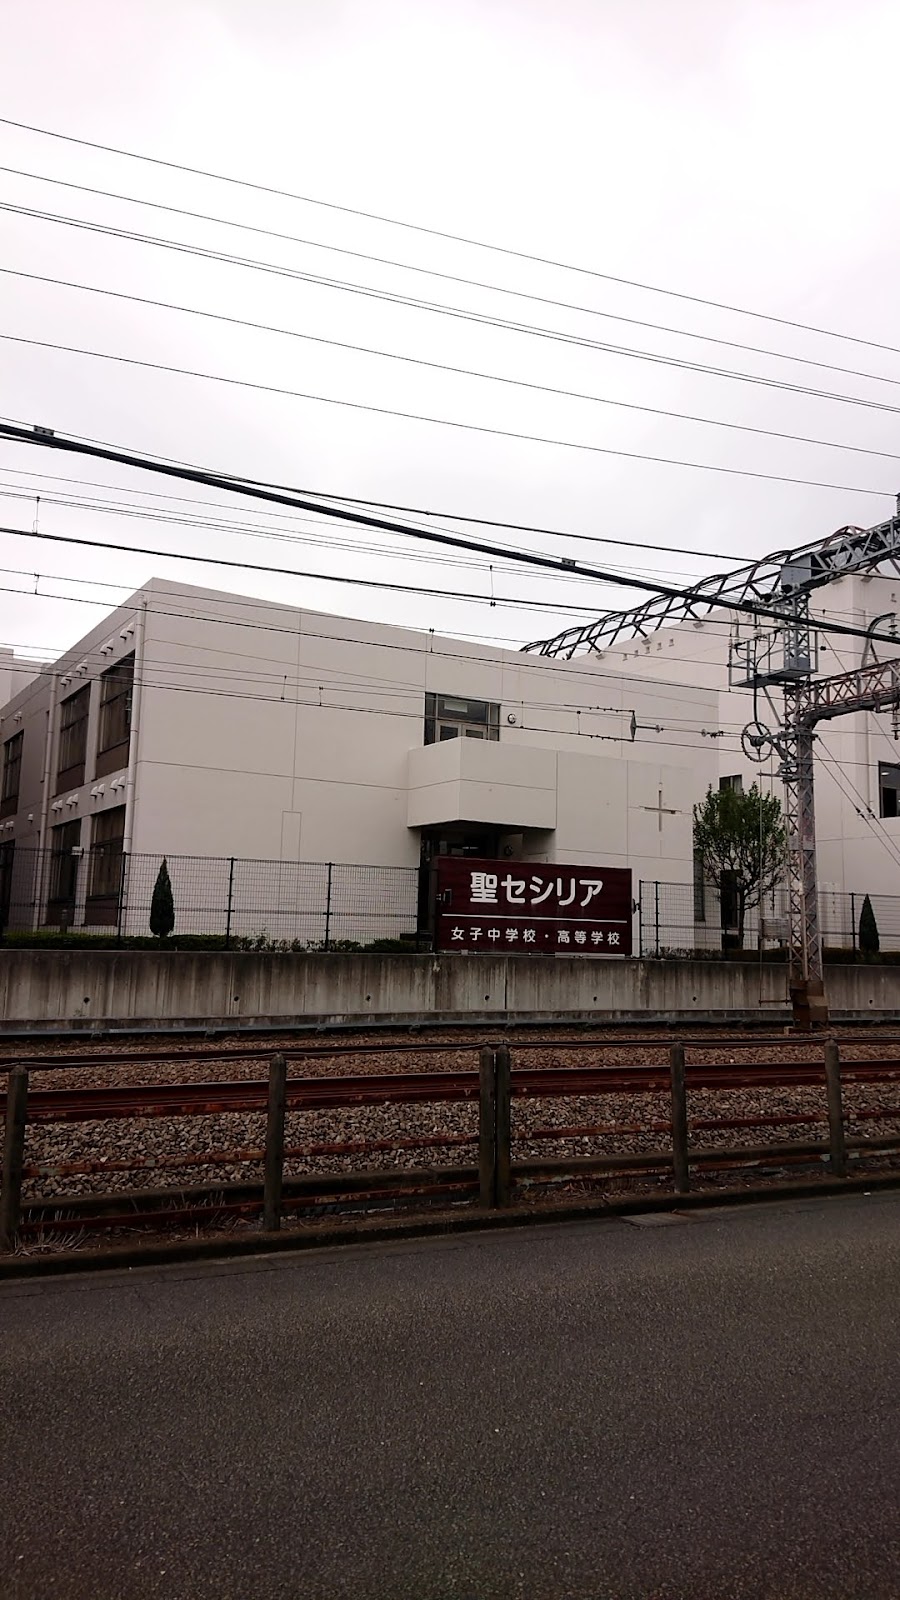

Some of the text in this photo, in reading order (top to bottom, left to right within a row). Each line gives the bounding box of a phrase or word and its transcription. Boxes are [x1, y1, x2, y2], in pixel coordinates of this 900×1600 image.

[469, 872, 603, 907] 聖セシリア
[450, 926, 621, 946] 女子中学校・高等学校
